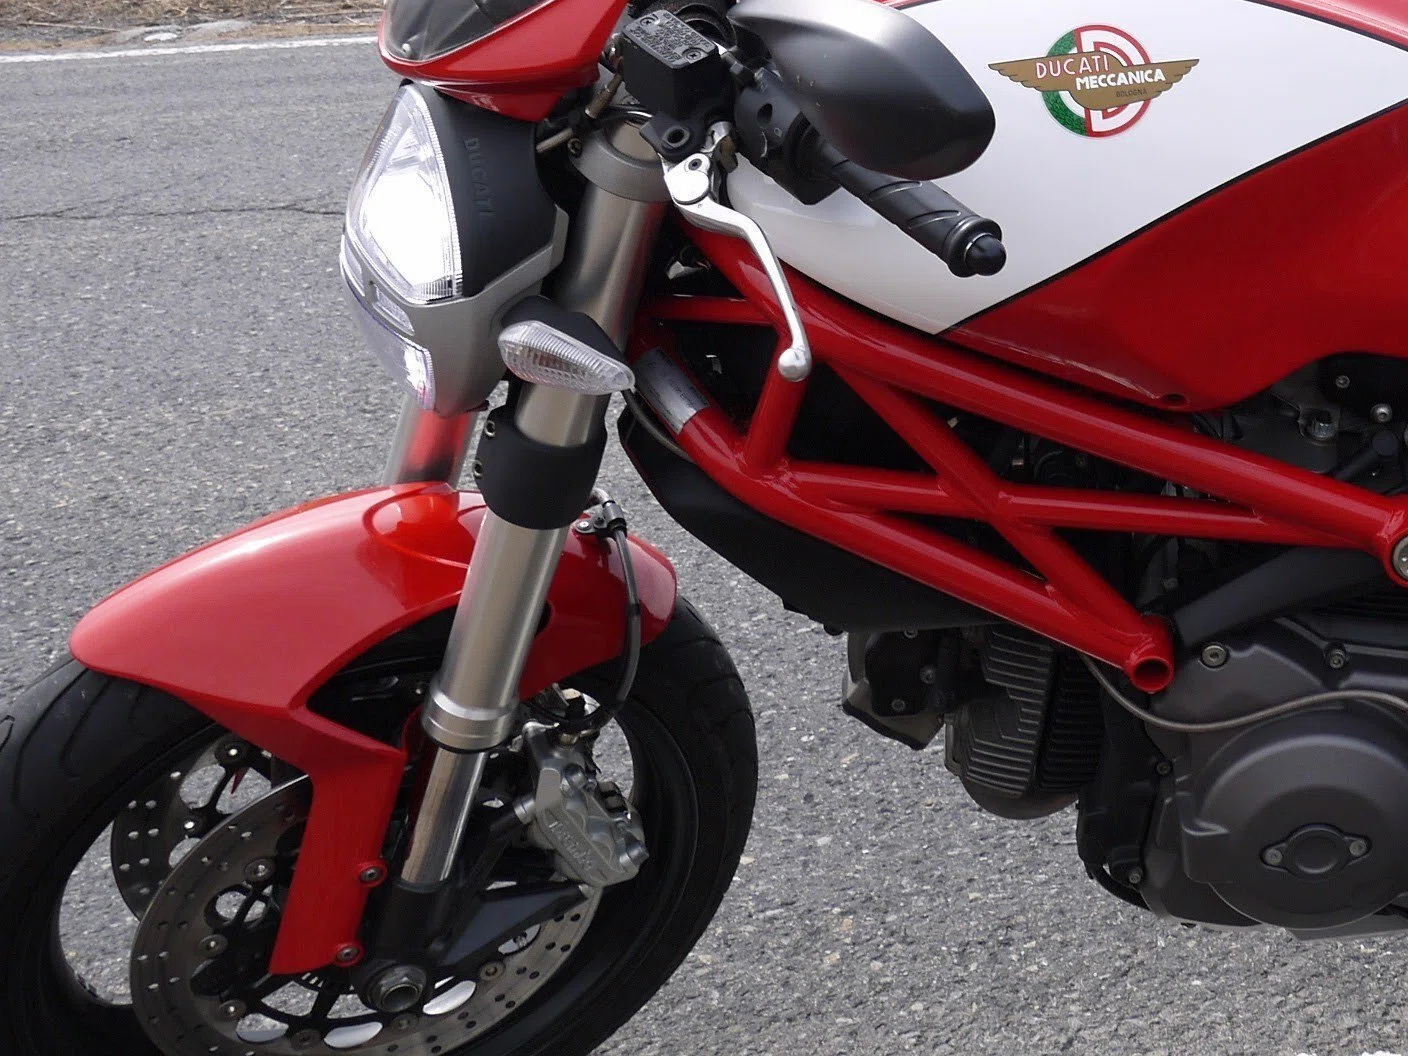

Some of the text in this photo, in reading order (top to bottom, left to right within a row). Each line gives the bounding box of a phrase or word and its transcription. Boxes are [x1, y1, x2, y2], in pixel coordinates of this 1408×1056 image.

[1035, 54, 1109, 79] DUCATI
[1075, 68, 1166, 91] MECCANICA
[1116, 90, 1148, 98] BOLOGNA
[463, 137, 496, 218] DUCATI
